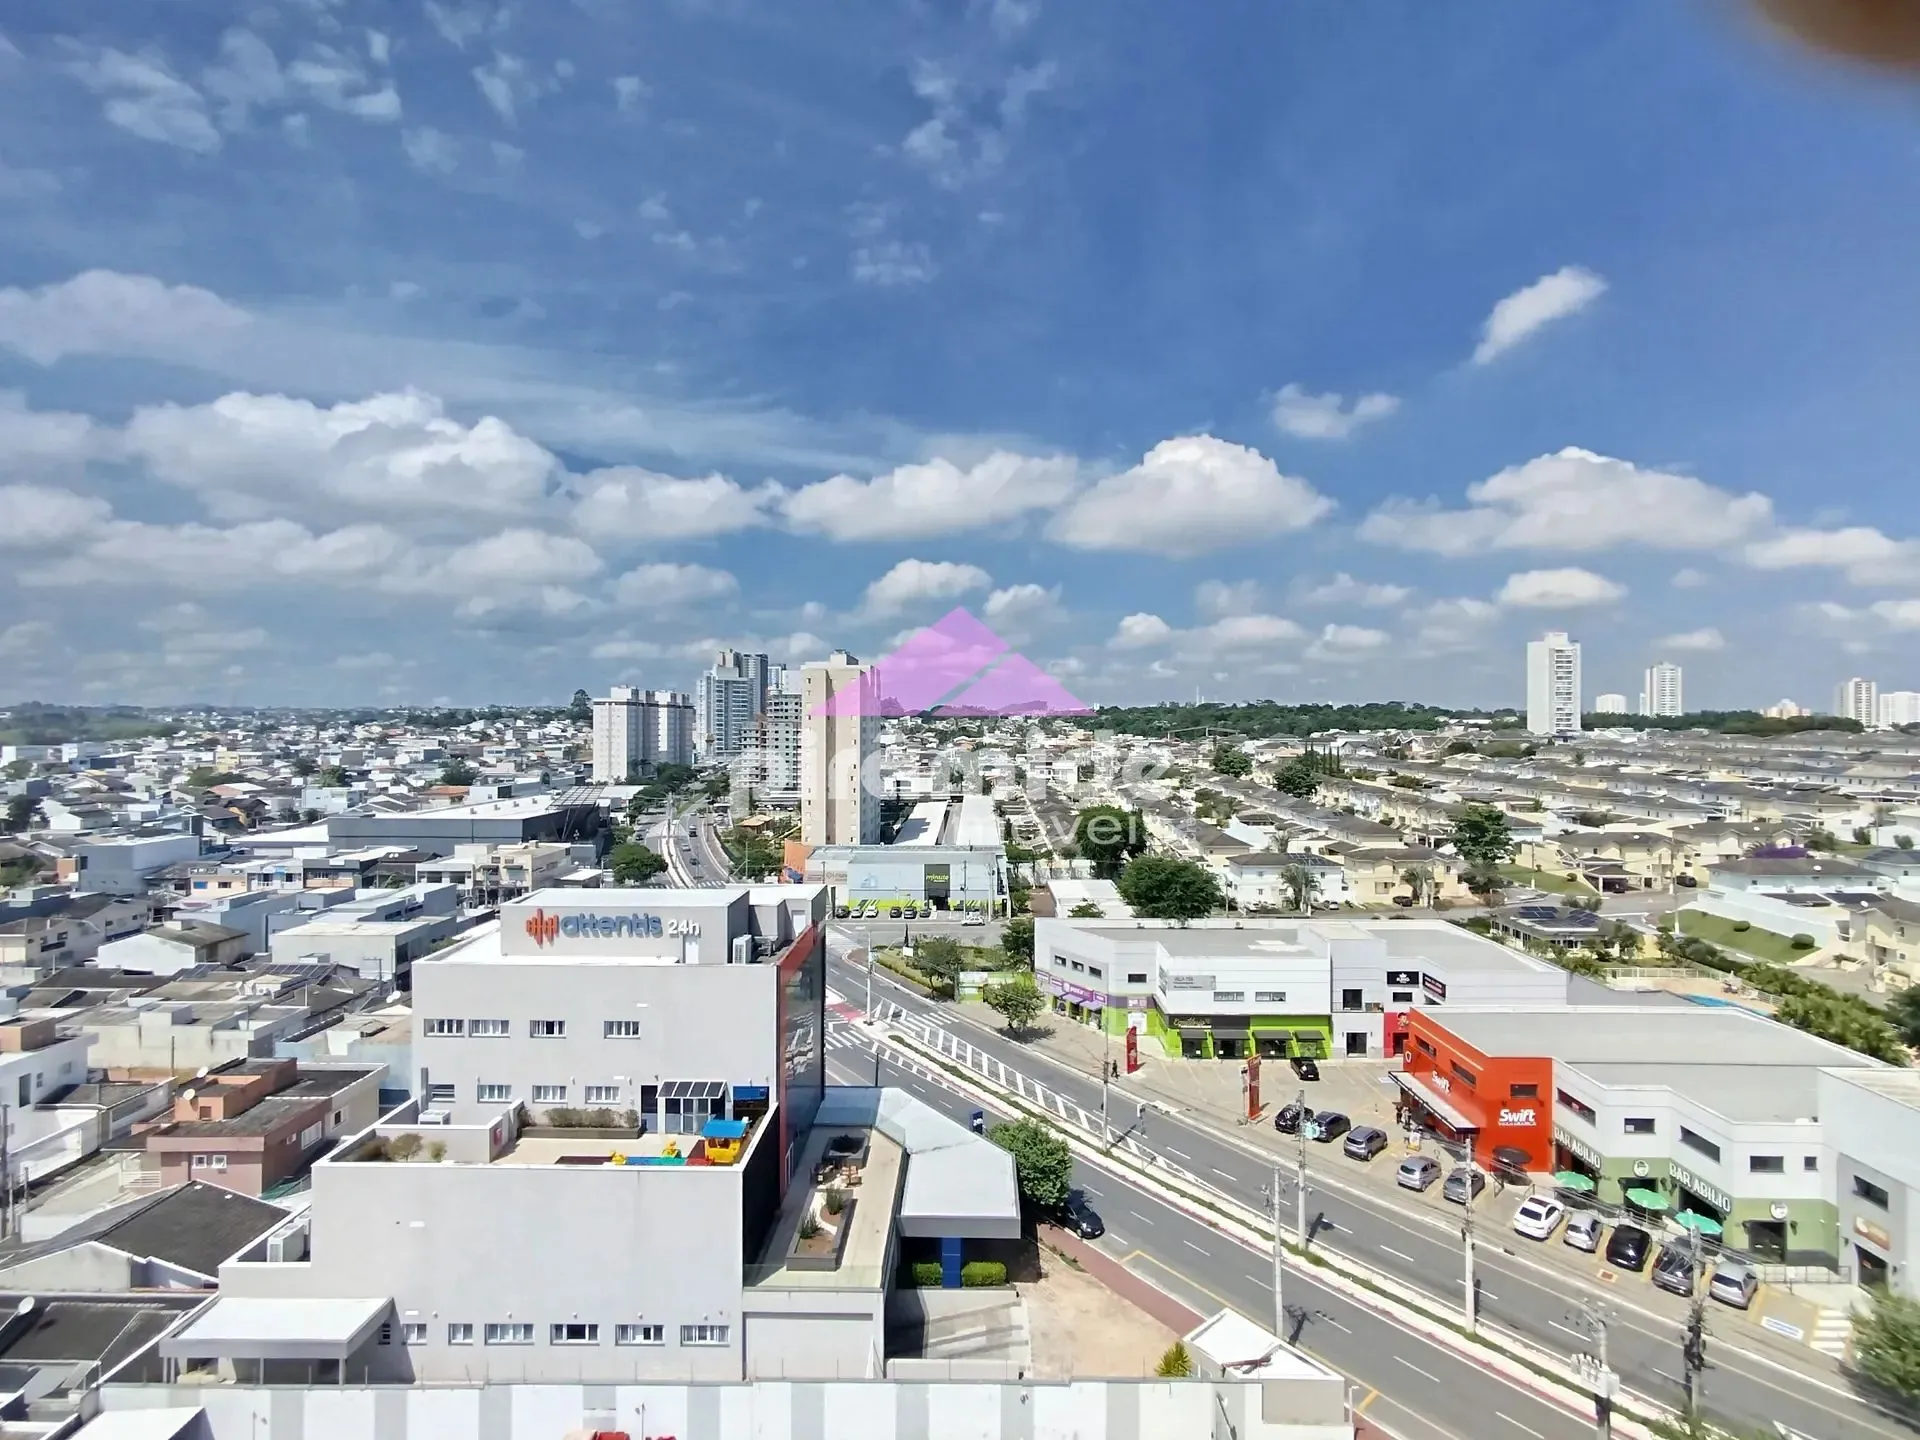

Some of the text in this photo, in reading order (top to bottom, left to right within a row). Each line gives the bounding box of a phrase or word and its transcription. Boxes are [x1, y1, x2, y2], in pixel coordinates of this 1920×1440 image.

[561, 913, 701, 938] attentis 24h
[1499, 1108, 1536, 1122] Swift
[1554, 1126, 1571, 1149] BAR
[1669, 1162, 1691, 1188] BAR
[1693, 1178, 1730, 1212] ABILIO
